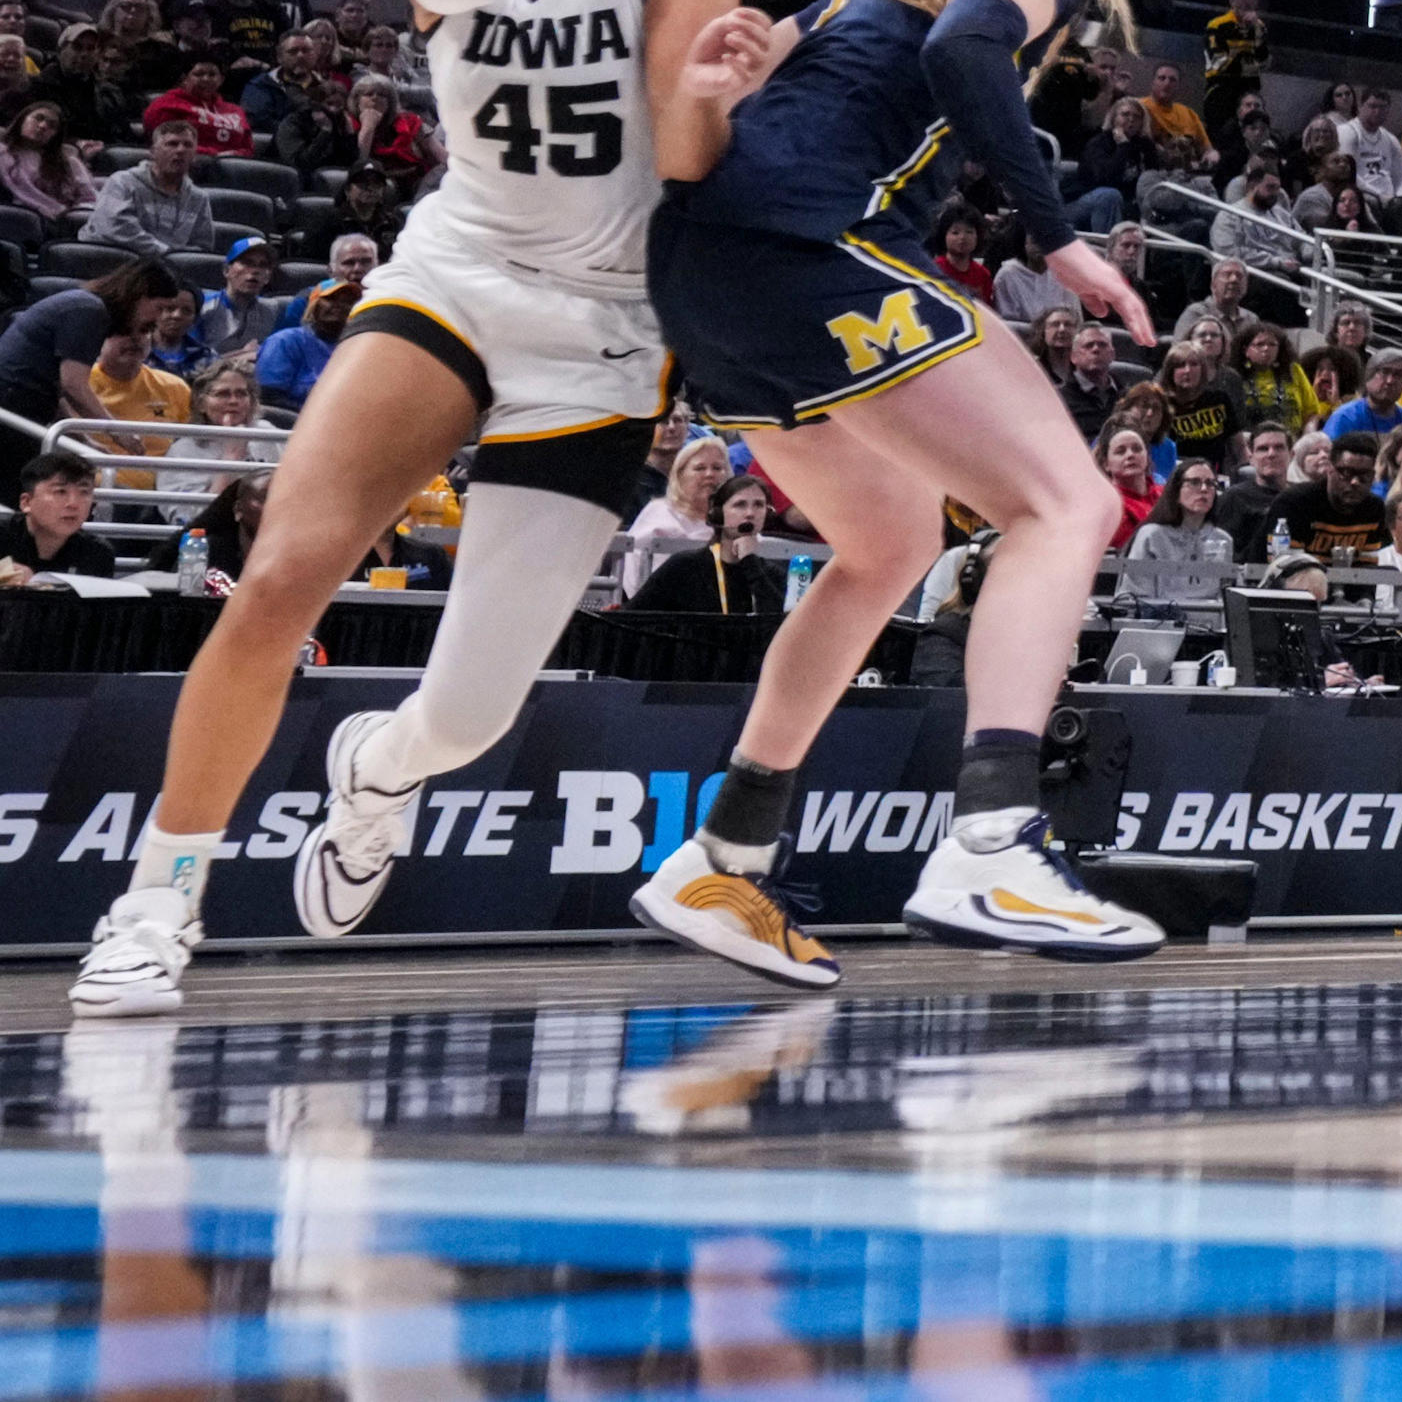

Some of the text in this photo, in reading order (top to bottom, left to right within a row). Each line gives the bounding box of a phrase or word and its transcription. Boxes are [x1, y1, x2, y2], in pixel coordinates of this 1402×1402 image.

[460, 8, 631, 70] IOWA
[472, 80, 624, 177] 45
[826, 288, 935, 376] M
